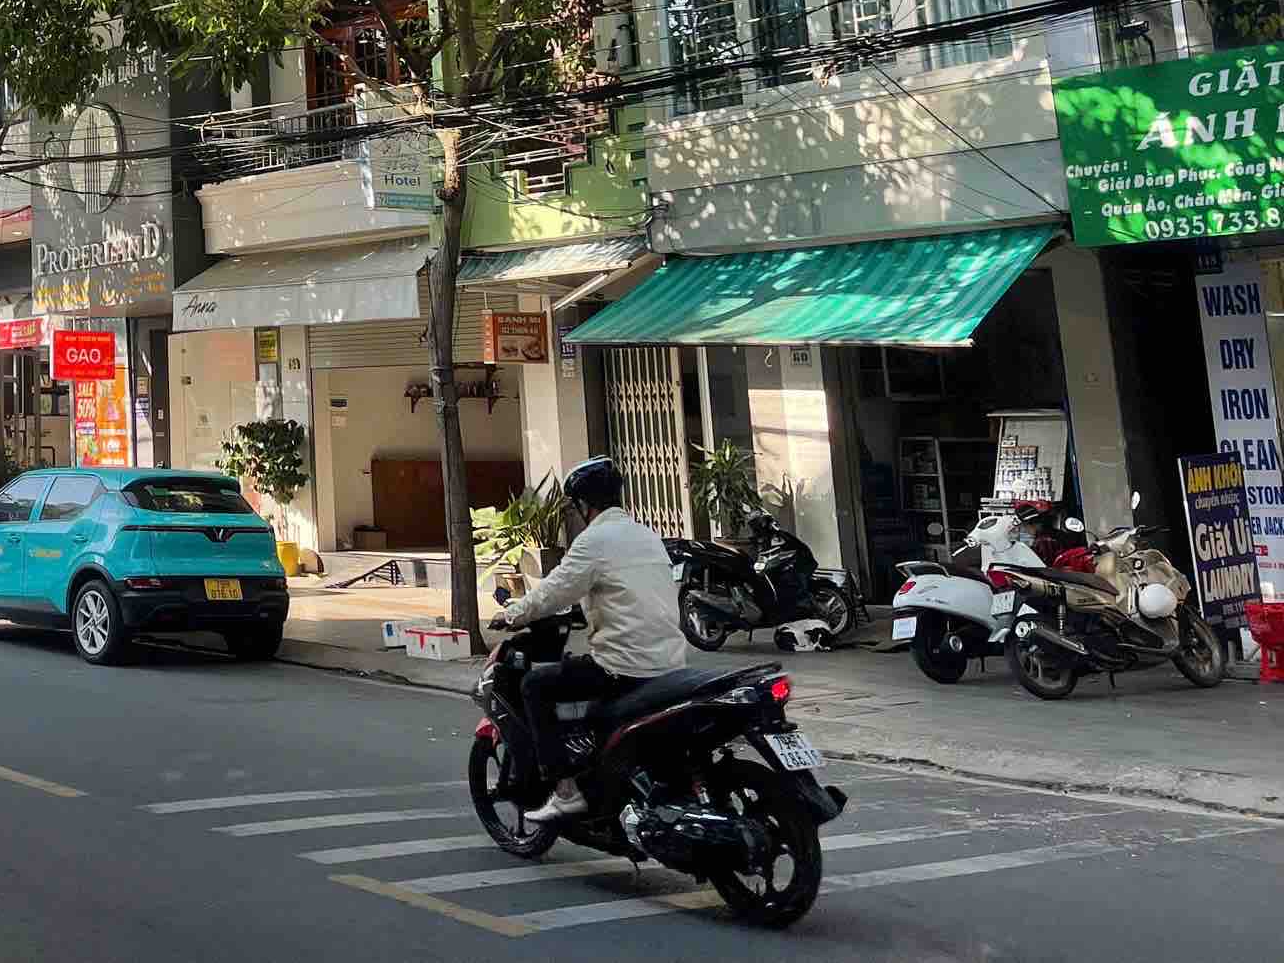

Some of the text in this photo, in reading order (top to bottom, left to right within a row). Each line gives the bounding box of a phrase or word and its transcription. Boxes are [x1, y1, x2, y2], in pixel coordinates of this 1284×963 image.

[385, 172, 421, 187] Hotel
[1202, 283, 1262, 318] WASH
[66, 348, 101, 364] GAO
[1219, 338, 1255, 370] DRY
[1220, 388, 1270, 421] IRON
[1202, 562, 1256, 603] LAUNDRY
